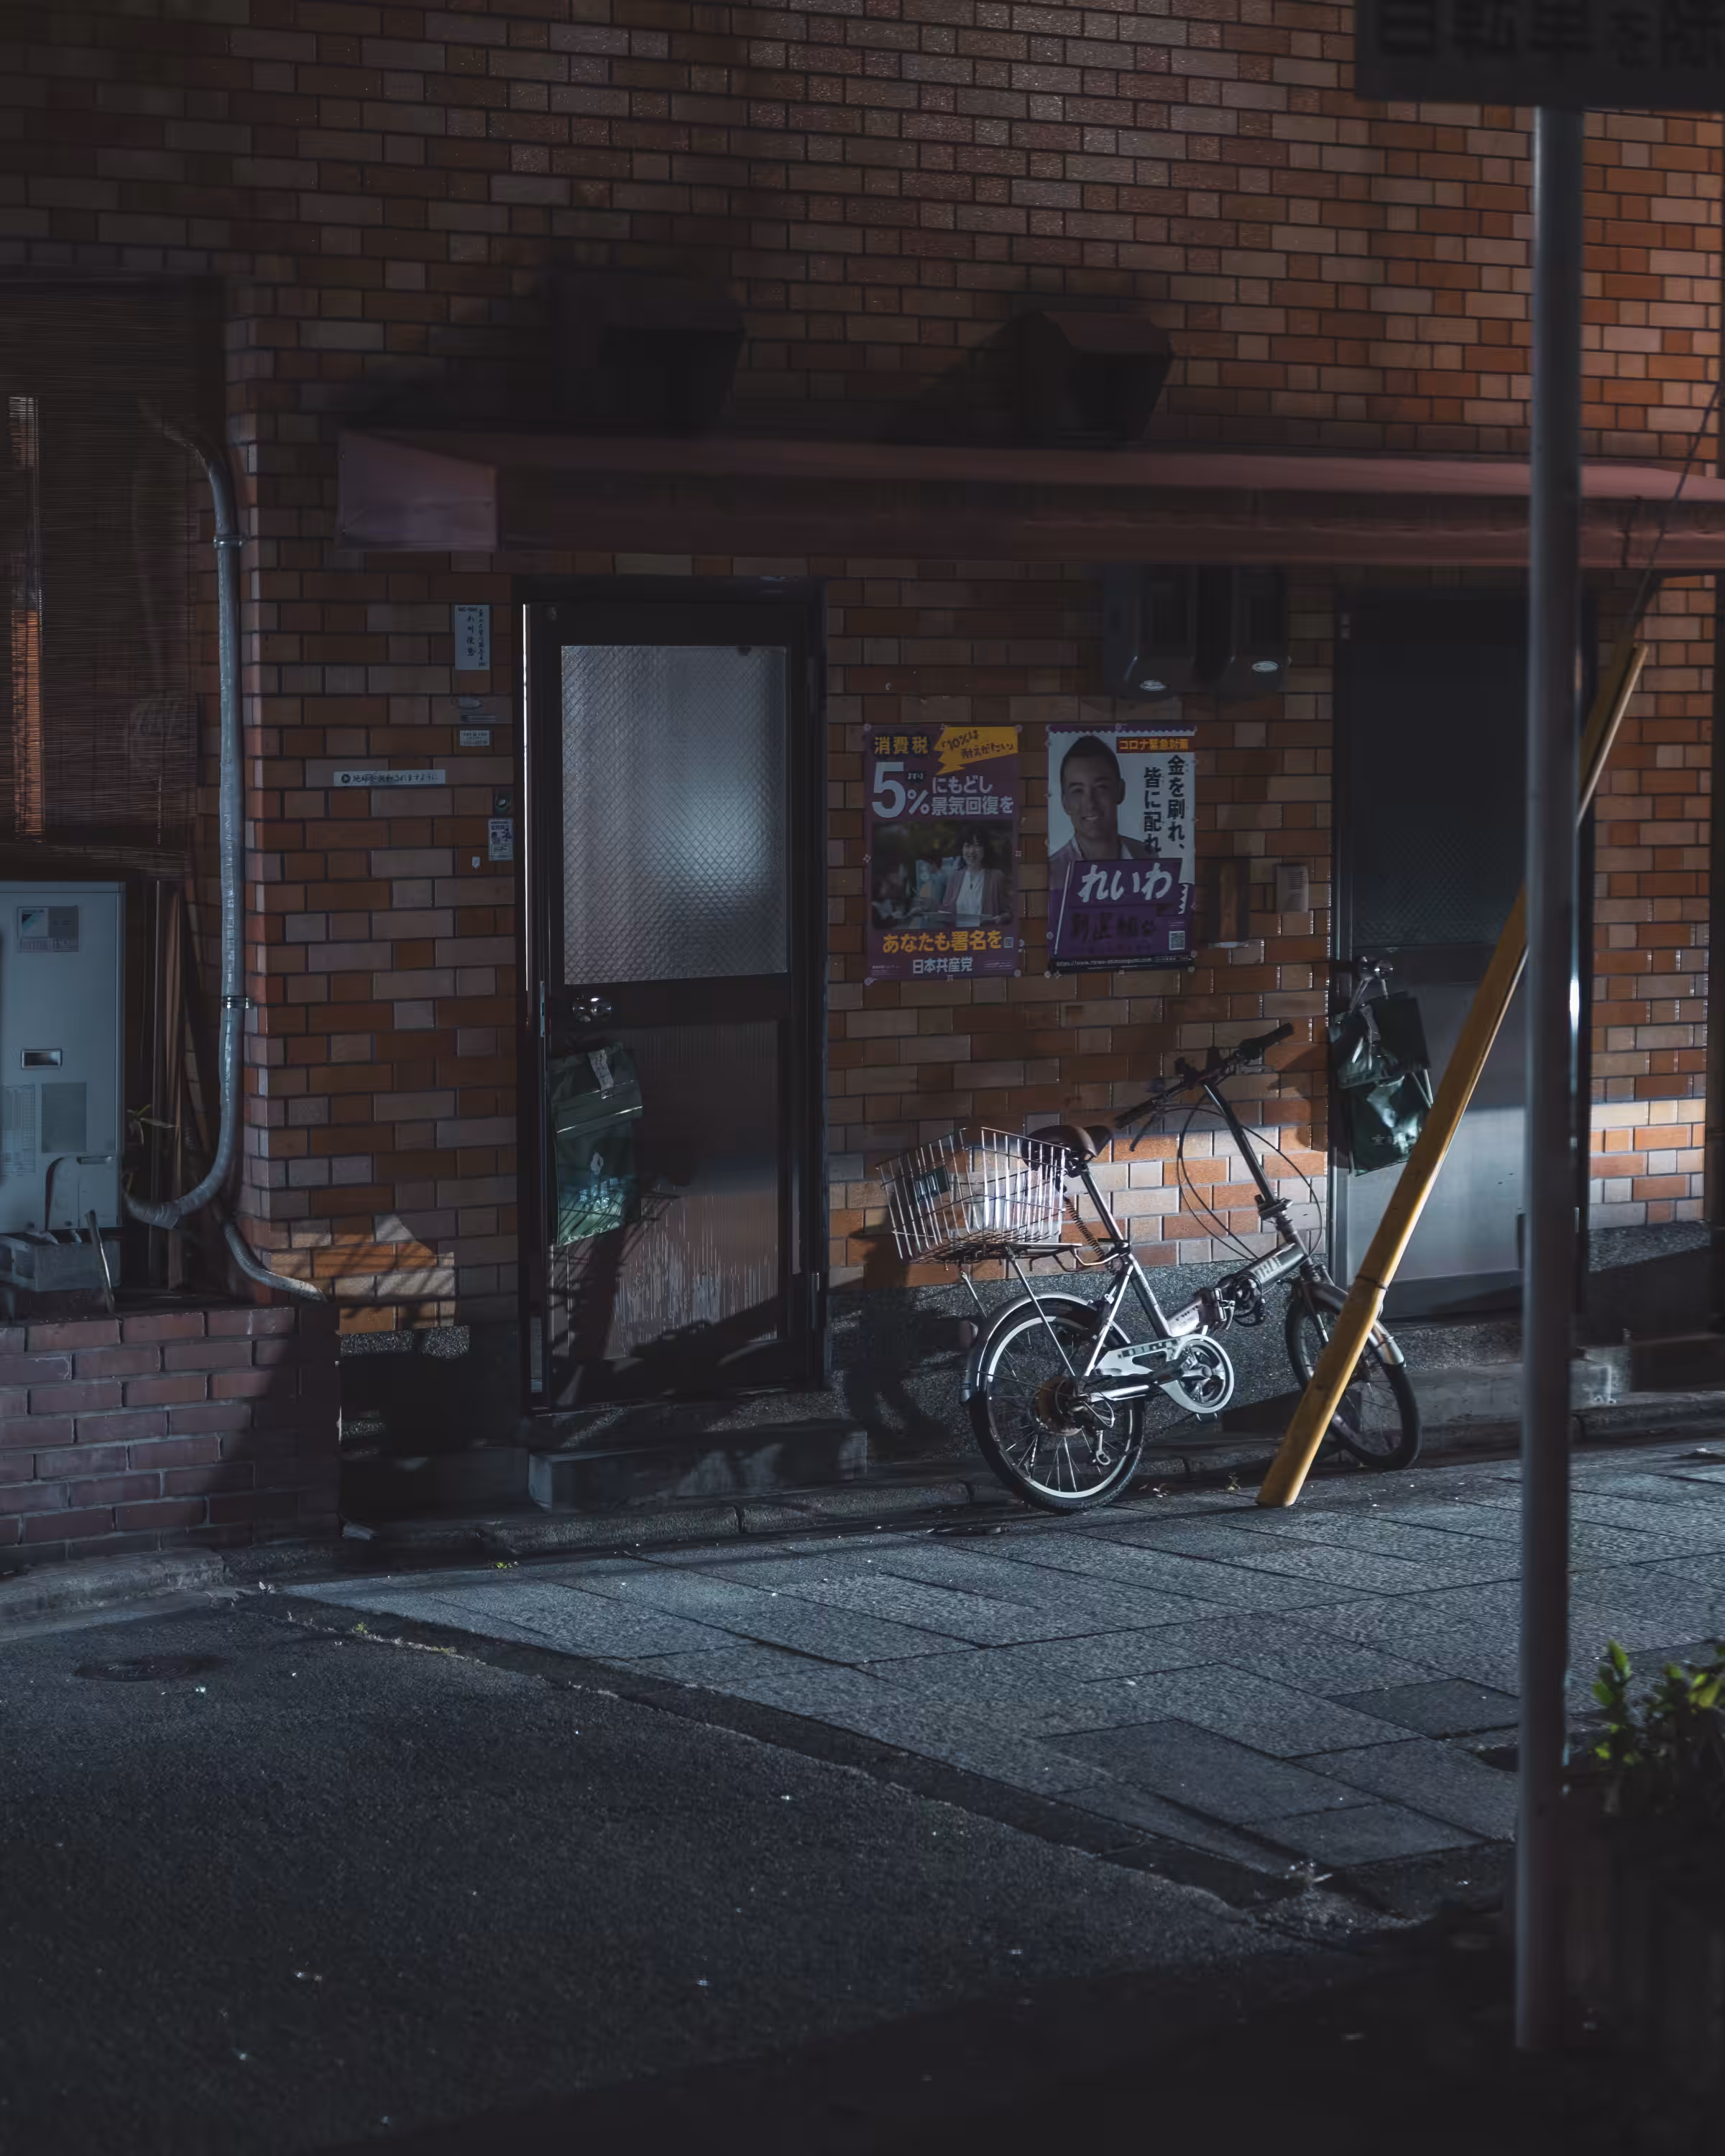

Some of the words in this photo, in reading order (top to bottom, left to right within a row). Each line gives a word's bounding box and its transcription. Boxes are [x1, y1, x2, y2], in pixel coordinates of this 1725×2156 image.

[874, 735, 929, 754] 消費税
[932, 775, 993, 794] にもどし
[932, 795, 1014, 816] 景気回復を
[1144, 766, 1162, 853] 皆に配れ
[1167, 755, 1186, 849] 金を刷れ、
[1077, 862, 1173, 903] れいわ
[882, 930, 1002, 954] あなたも署名を
[912, 956, 973, 975] 日本共産党
